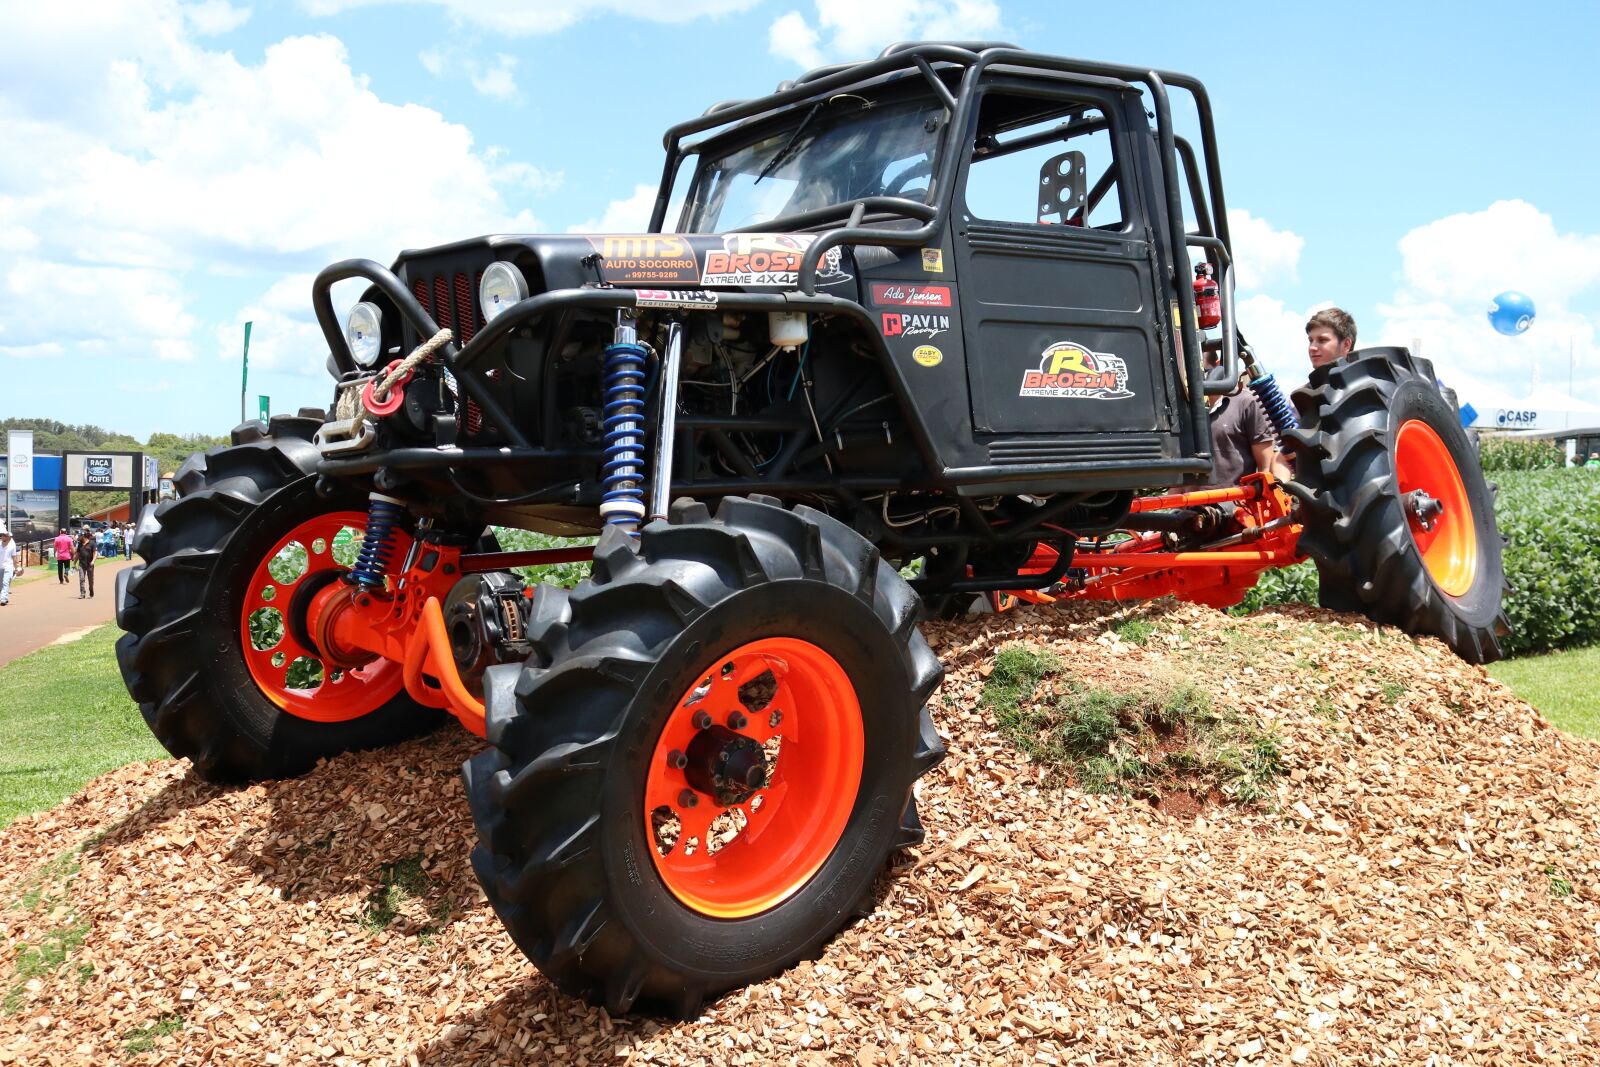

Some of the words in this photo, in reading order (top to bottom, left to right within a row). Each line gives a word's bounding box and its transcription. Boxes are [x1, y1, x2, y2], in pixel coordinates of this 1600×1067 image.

[605, 260, 636, 269] AUTO
[639, 260, 693, 269] SOCORRO
[704, 275, 751, 284] EXTREME
[905, 287, 942, 304] Jensen
[901, 314, 950, 329] PAVIN
[901, 326, 948, 340] Racing
[1048, 348, 1100, 376] R
[1023, 371, 1117, 389] BROSIN
[1506, 410, 1537, 422] CASP
[90, 459, 109, 468] RAÇA
[88, 475, 110, 483] FORTE
